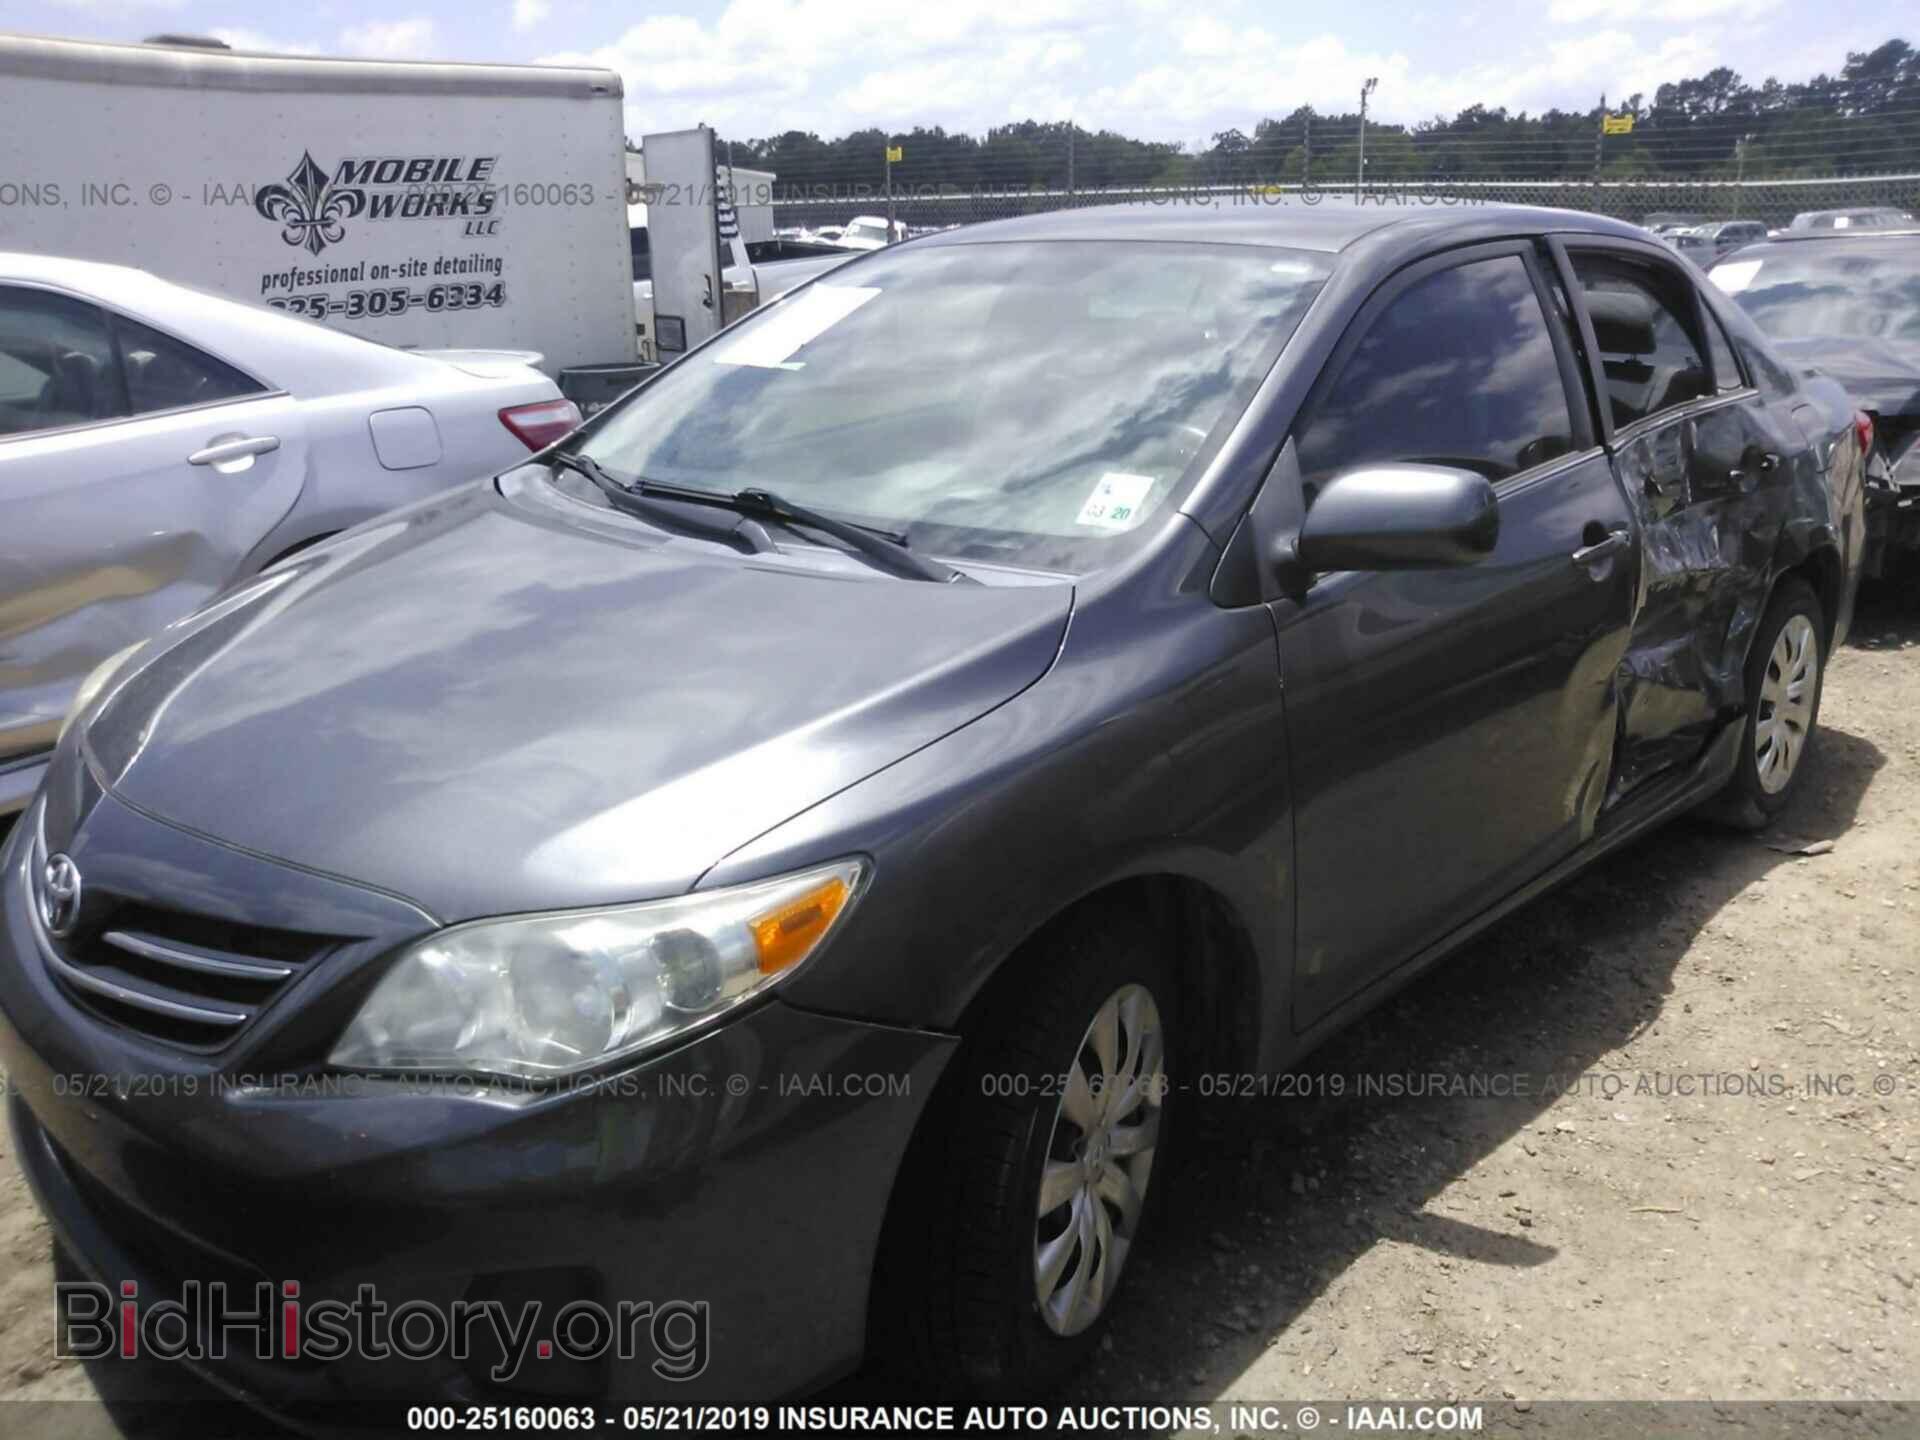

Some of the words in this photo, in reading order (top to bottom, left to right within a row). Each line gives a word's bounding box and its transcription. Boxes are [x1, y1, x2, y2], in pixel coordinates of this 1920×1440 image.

[333, 157, 496, 185] MOBILE
[368, 192, 497, 219] WORKS
[465, 220, 500, 236] LLC
[261, 260, 365, 294] professional
[370, 257, 428, 281] on-site
[434, 253, 503, 277] detailing
